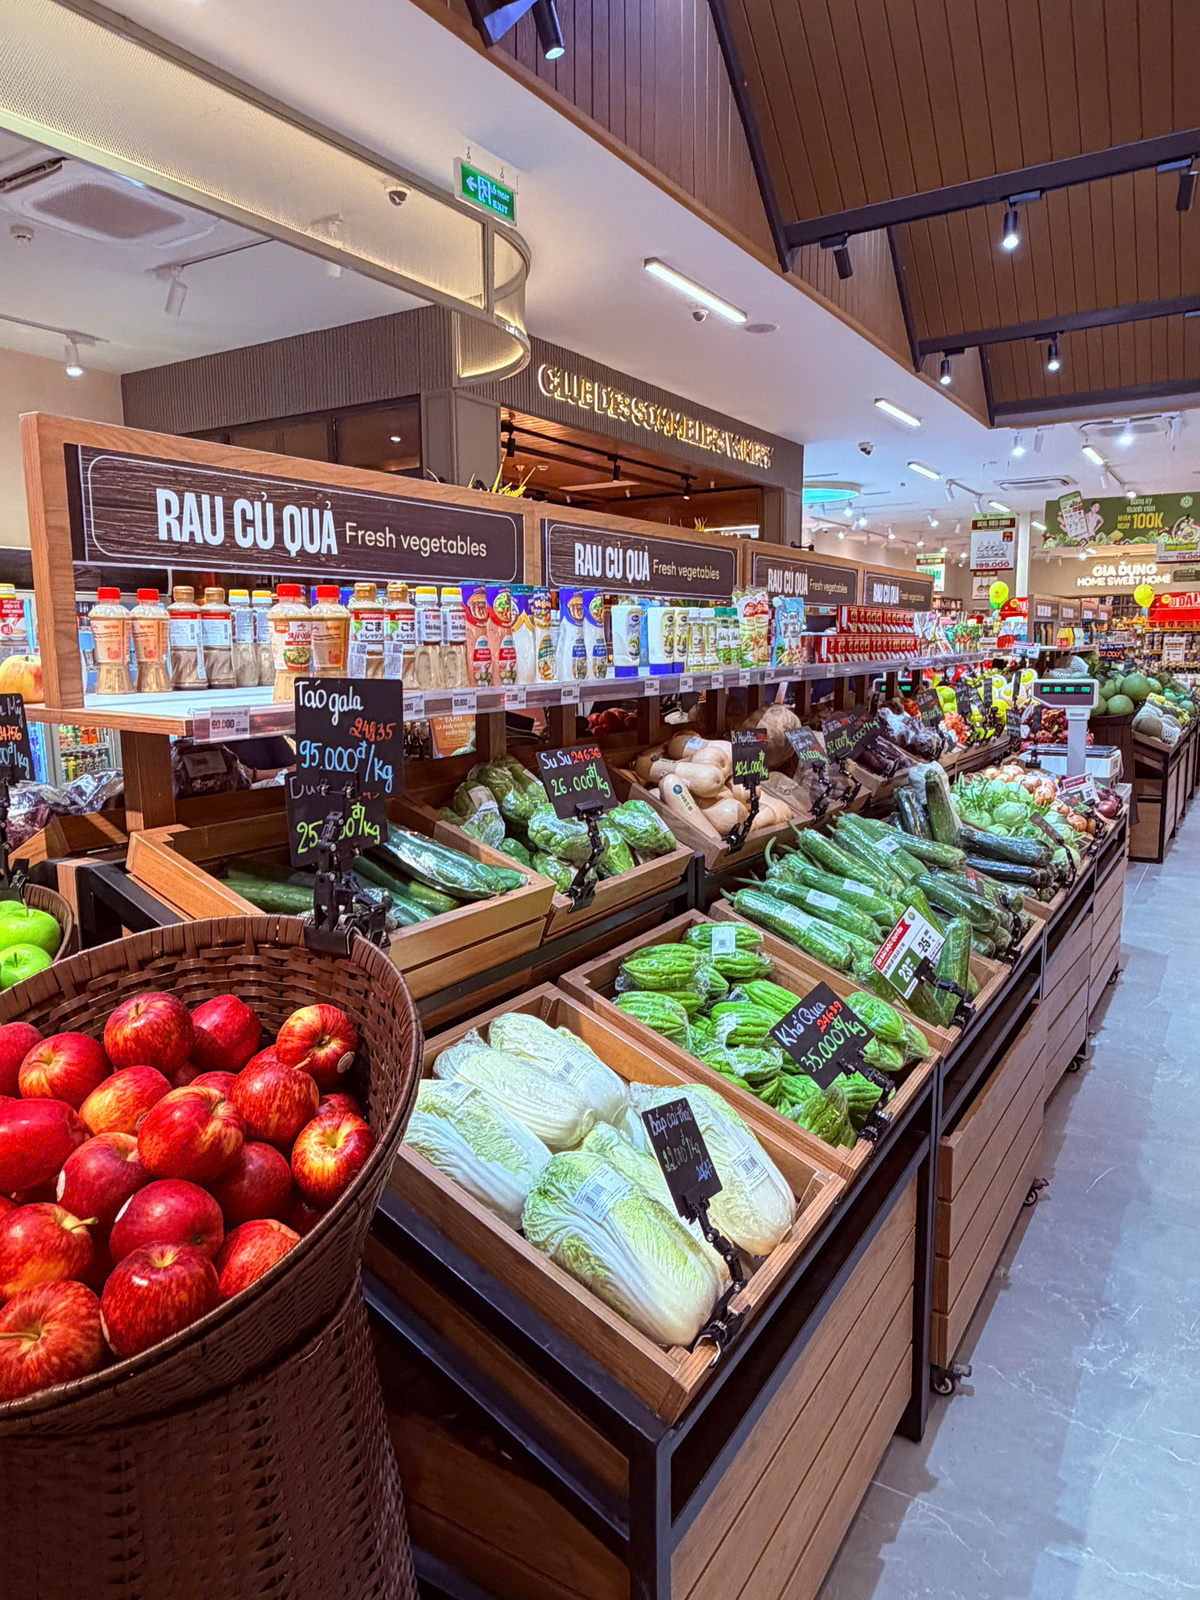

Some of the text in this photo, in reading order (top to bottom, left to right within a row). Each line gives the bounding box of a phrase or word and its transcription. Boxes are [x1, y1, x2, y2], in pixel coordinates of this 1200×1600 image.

[493, 200, 508, 214] EXIT
[156, 488, 487, 557] RAU CỦ QUẢ Fresh vegetables
[1132, 512, 1163, 529] 100K
[574, 541, 720, 583] RAU CỦ QUẢ Fresh vegetables
[1092, 564, 1117, 577] GIA
[767, 567, 848, 597] RAU CỦ QUẢ Fresh vegetables
[1076, 574, 1171, 587] HOME SWEET HOME
[328, 686, 364, 726] gala
[540, 752, 558, 770] Su
[557, 750, 572, 766] Su
[917, 937, 932, 953] 25
[898, 963, 914, 983] 23
[774, 1001, 827, 1047] Khổ Qua
